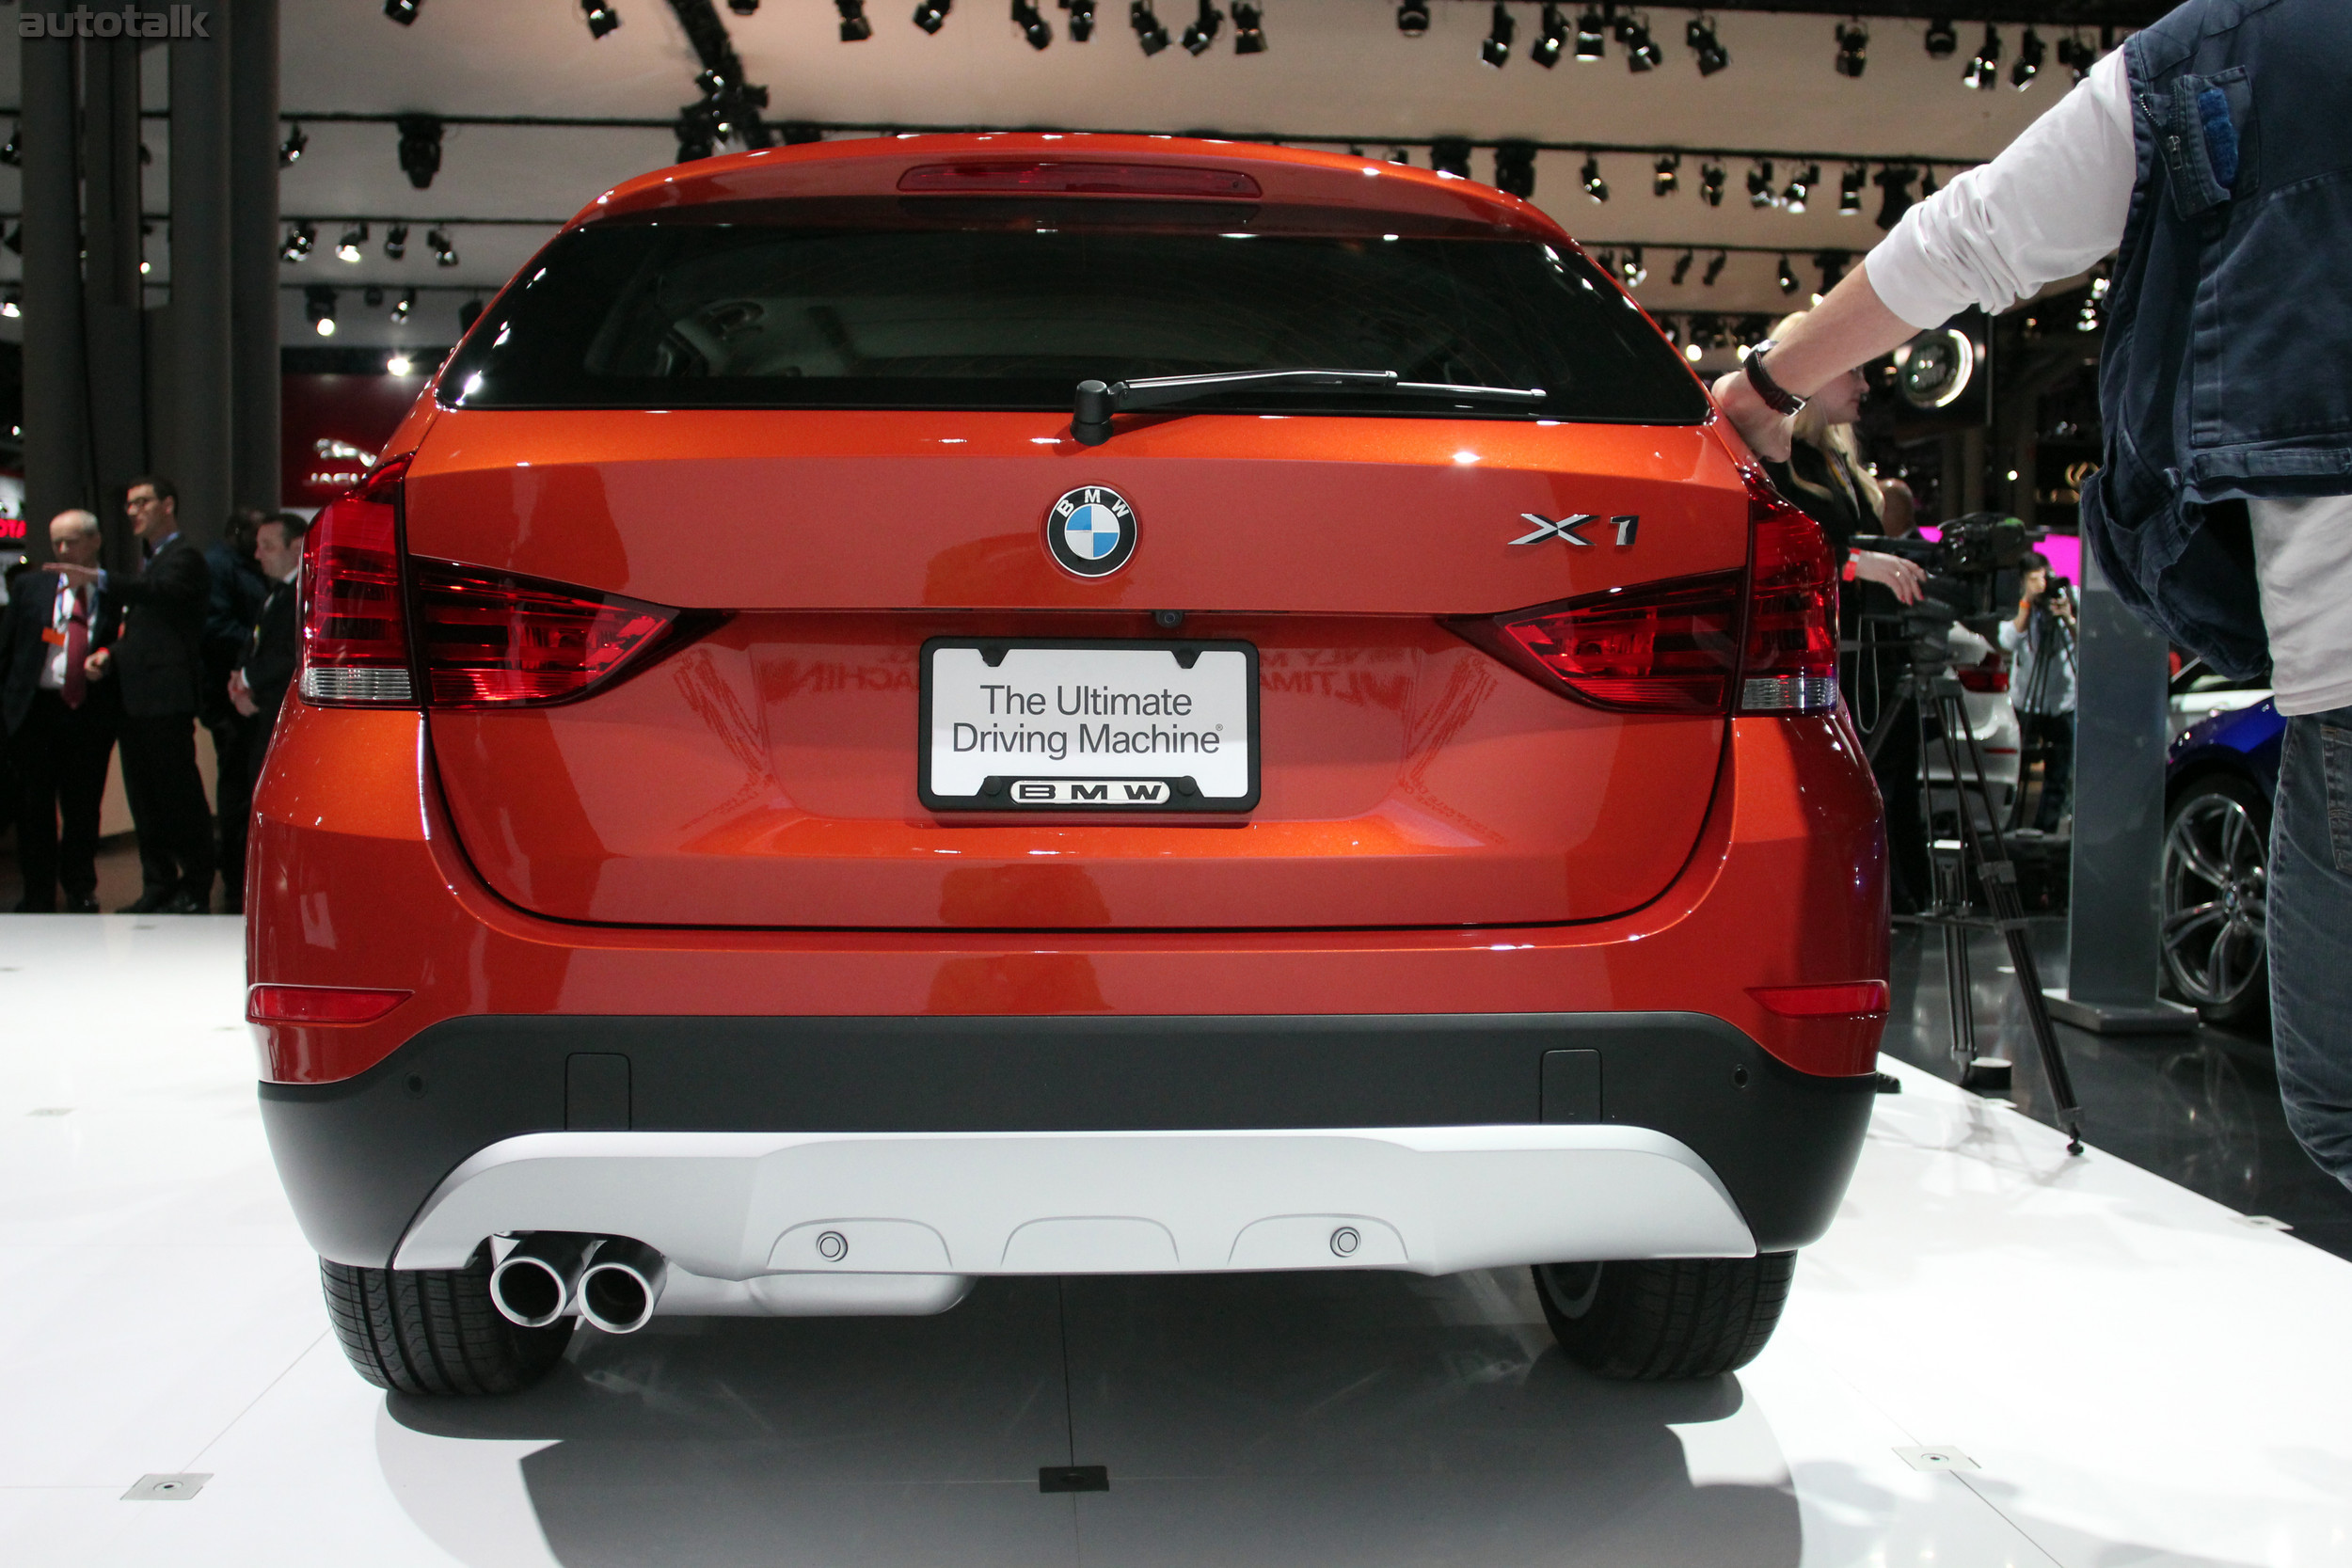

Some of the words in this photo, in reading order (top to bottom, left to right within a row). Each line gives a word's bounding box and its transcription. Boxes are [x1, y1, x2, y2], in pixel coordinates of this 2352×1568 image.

[1057, 488, 1129, 518] BMW
[1507, 514, 1640, 546] X1
[979, 685, 1046, 715] The
[1057, 685, 1192, 716] Ultimate
[953, 722, 1068, 760] Driving
[1019, 784, 1162, 800] BMW
